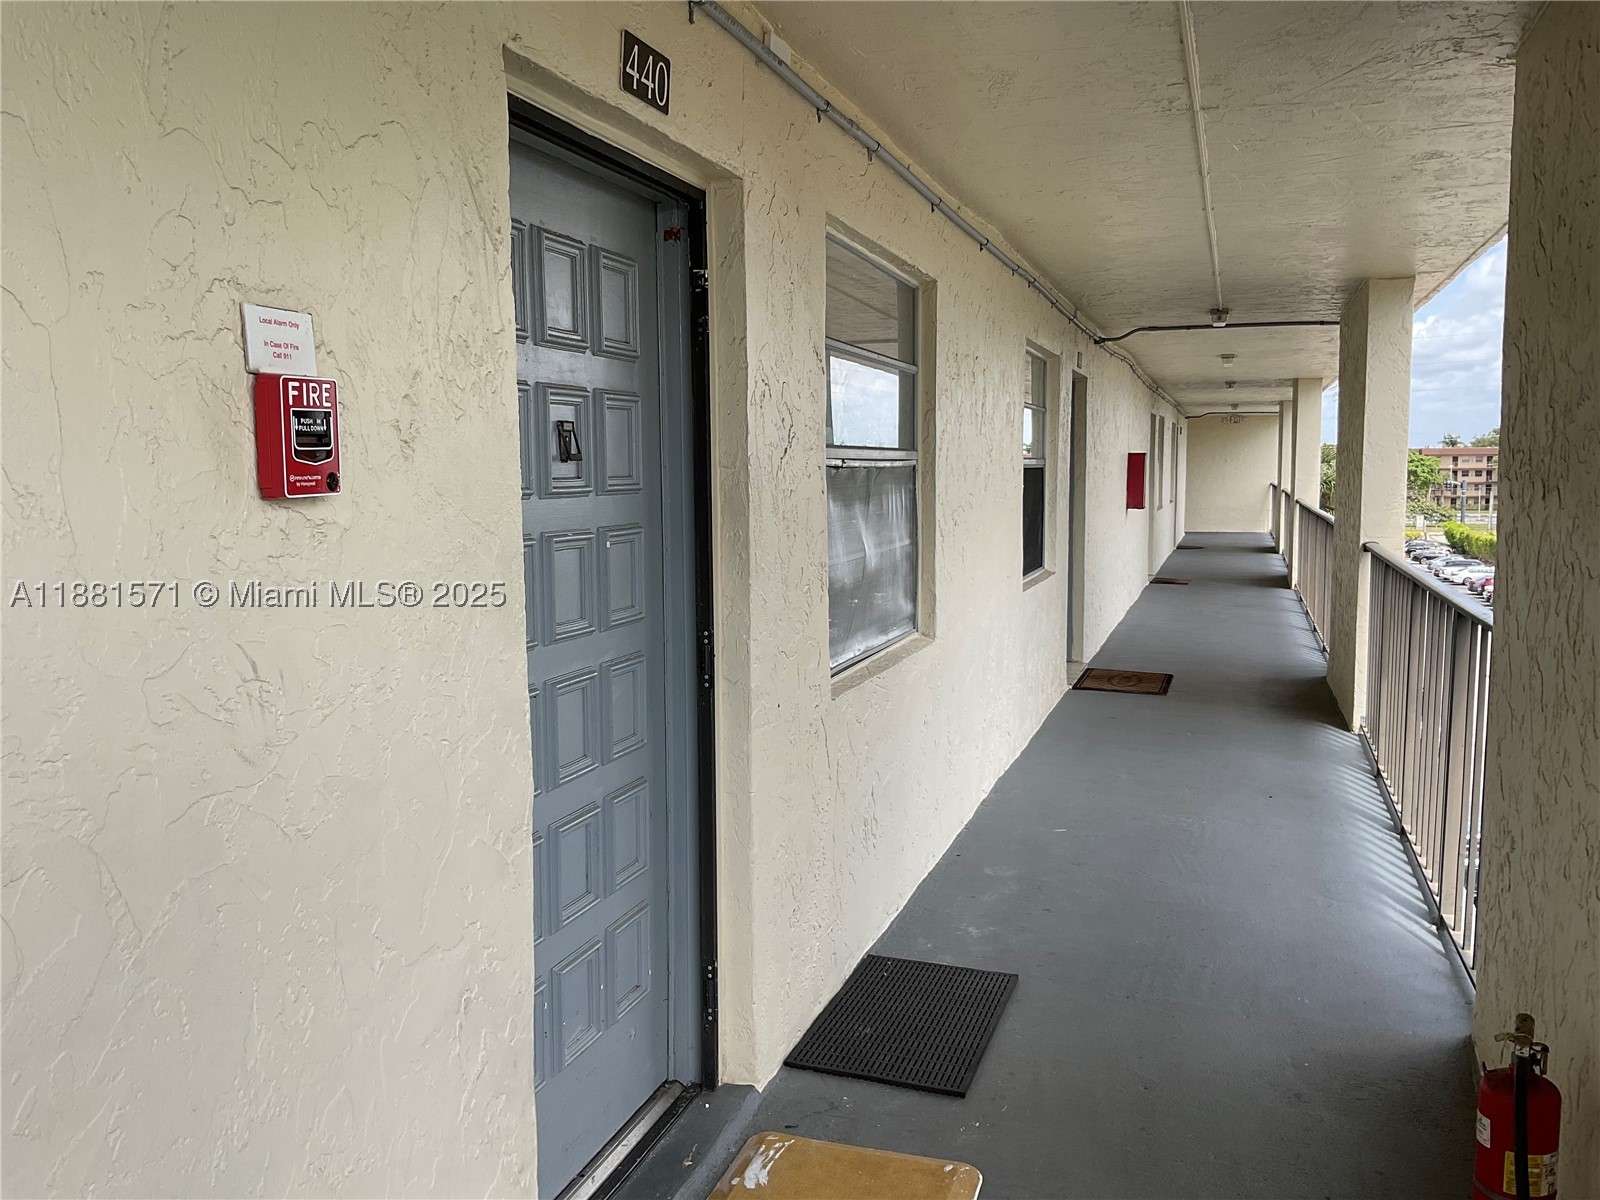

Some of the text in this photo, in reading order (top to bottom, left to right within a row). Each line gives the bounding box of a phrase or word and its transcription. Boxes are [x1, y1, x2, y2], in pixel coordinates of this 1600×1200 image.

[626, 44, 668, 106] 440
[258, 316, 300, 330] Local Alarm Only
[269, 340, 282, 349] Case
[282, 342, 289, 350] Of
[290, 343, 300, 351] Fire
[272, 351, 292, 360] Call 911
[288, 381, 332, 407] FIRE
